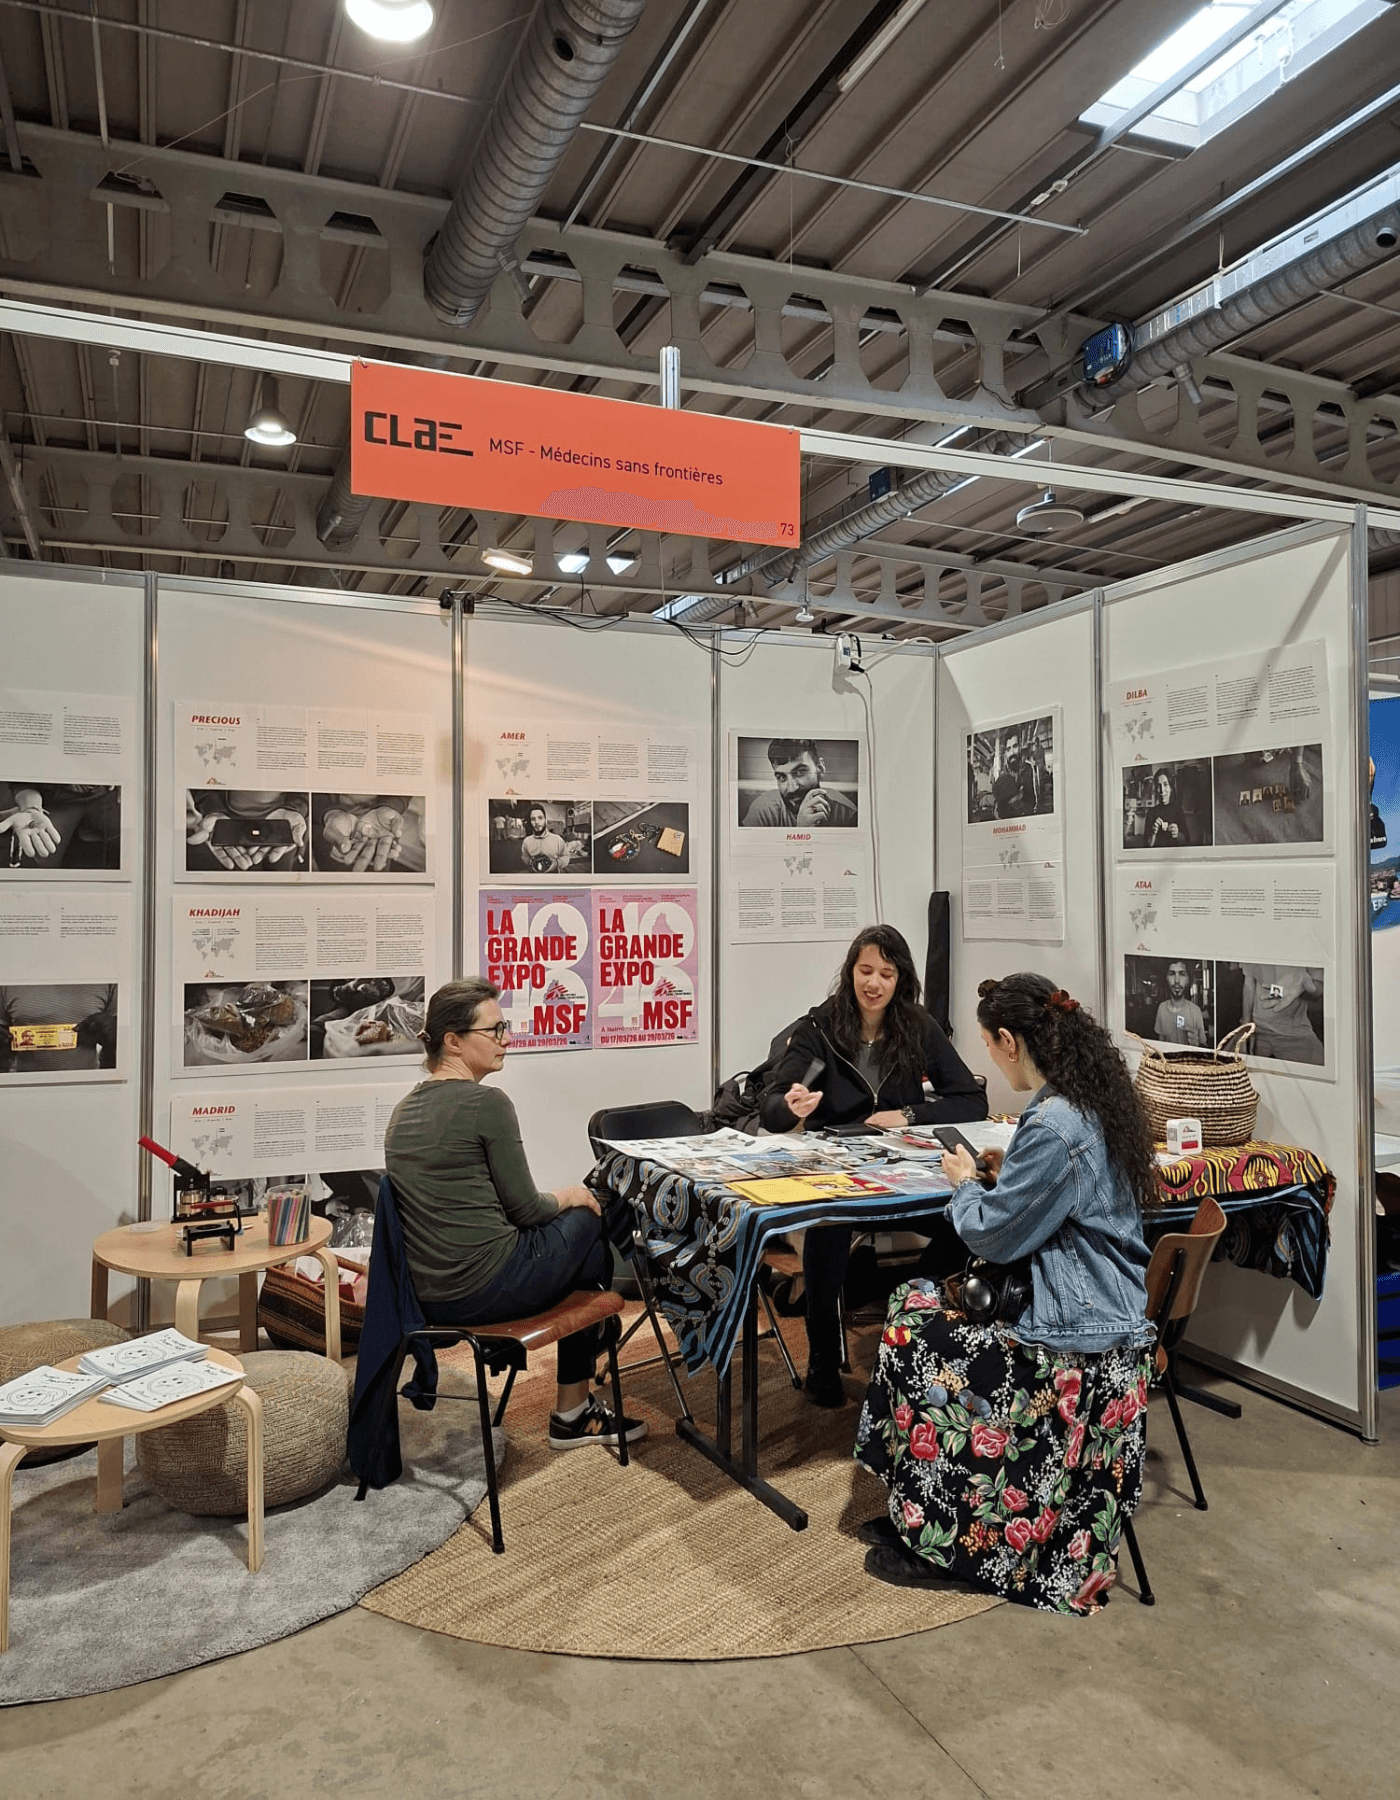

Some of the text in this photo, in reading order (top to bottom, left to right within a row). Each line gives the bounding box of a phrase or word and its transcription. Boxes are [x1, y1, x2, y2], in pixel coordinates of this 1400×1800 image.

[489, 437, 525, 456] MSF
[540, 444, 611, 469] Médecins
[615, 459, 650, 475] sans
[654, 461, 723, 485] frontières
[780, 522, 795, 537] 73
[1126, 688, 1148, 700] DILBA
[191, 715, 241, 725] PRECIOUS
[500, 732, 526, 741] AMER
[786, 833, 812, 841] HAMID
[992, 824, 1027, 835] MOHAMMAD
[1134, 881, 1152, 889] ATAA
[189, 908, 241, 918] KHADIJAH
[600, 908, 625, 933] LA
[487, 909, 515, 935] LA
[487, 935, 578, 963] GRANDE
[600, 933, 684, 960] GRANDE
[488, 963, 546, 990] EXPO
[600, 960, 655, 987] EXPO
[533, 1004, 586, 1036] MSF
[643, 1000, 693, 1031] MSF
[600, 1035, 610, 1044] DU
[638, 1033, 647, 1042] AU
[192, 1105, 236, 1116] MADRID
